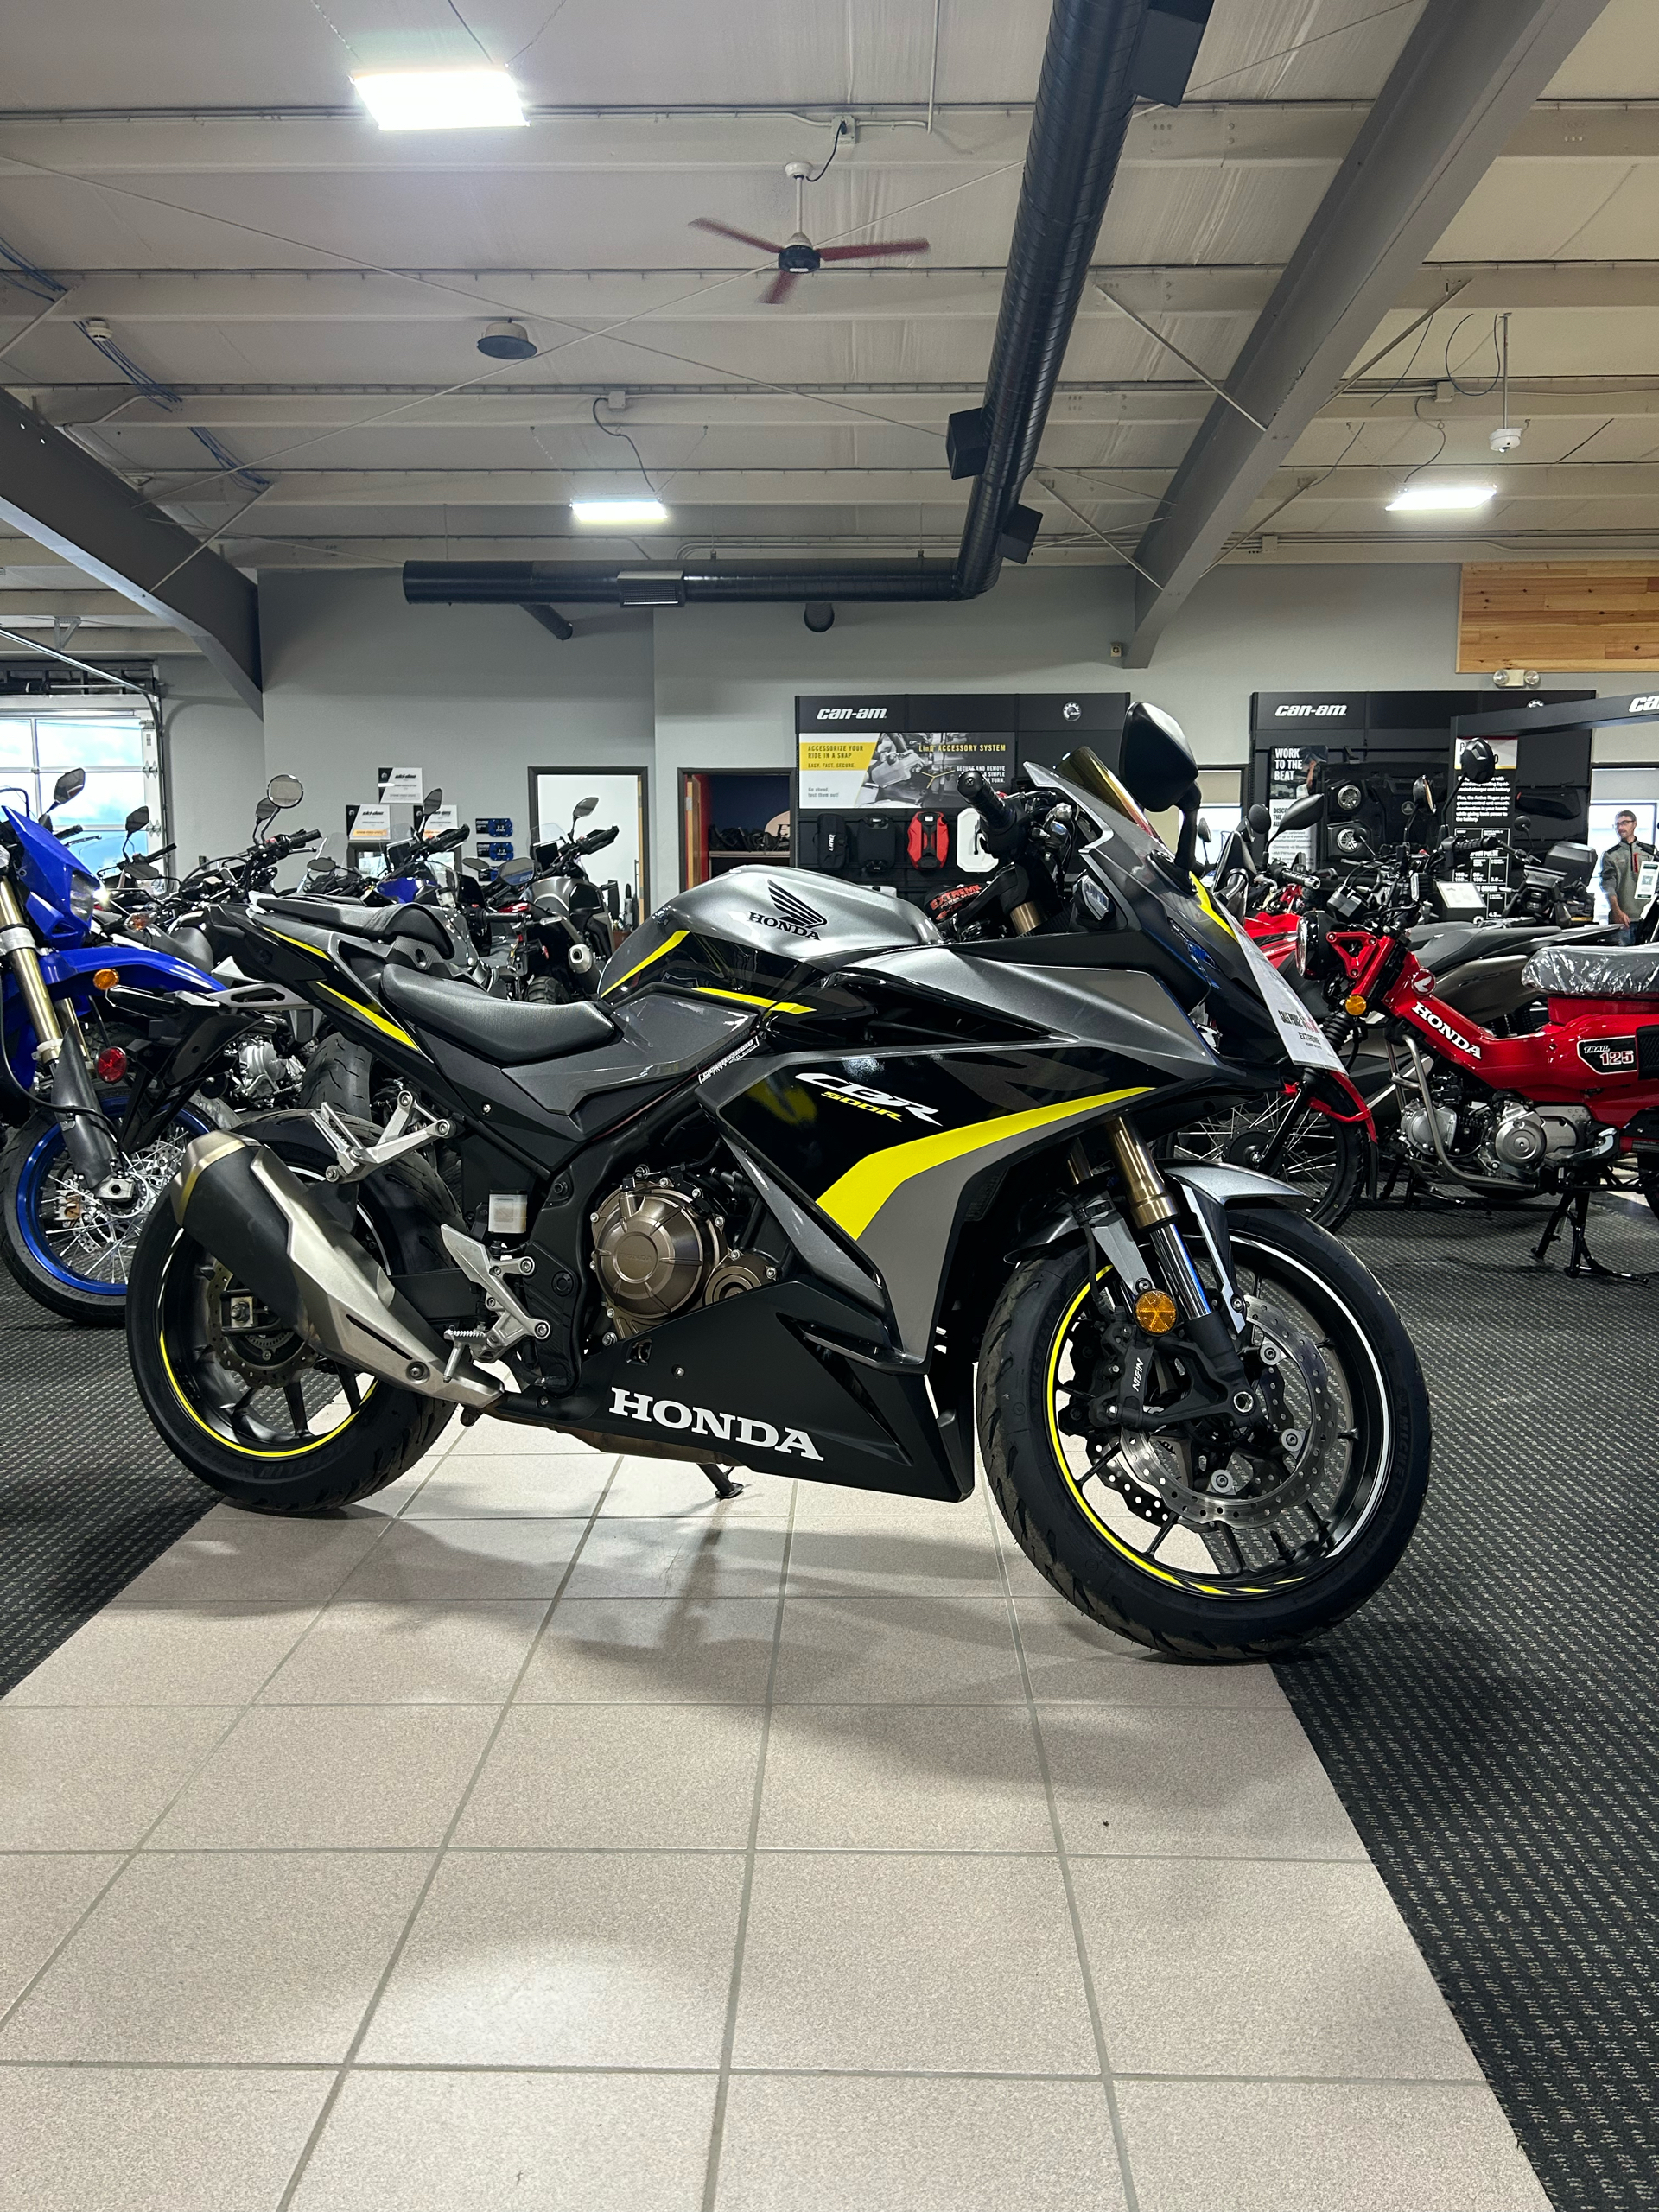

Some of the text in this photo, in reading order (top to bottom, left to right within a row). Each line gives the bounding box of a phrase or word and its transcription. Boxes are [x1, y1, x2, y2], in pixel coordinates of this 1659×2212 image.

[1274, 703, 1347, 716] can-am
[1628, 695, 1659, 713] ca
[817, 707, 887, 721] can-am
[1274, 747, 1300, 759] WORK
[1274, 759, 1303, 770] TO THE
[1274, 770, 1294, 781] BEAT
[930, 884, 982, 911] EXTREME
[748, 911, 821, 941] HONDA
[1411, 1001, 1482, 1060] HONDA
[1584, 1045, 1610, 1053] TRAIL
[1599, 1050, 1634, 1066] 125
[795, 1072, 944, 1127] CBR
[820, 1091, 902, 1123] 500R
[608, 1386, 824, 1462] HONDA
